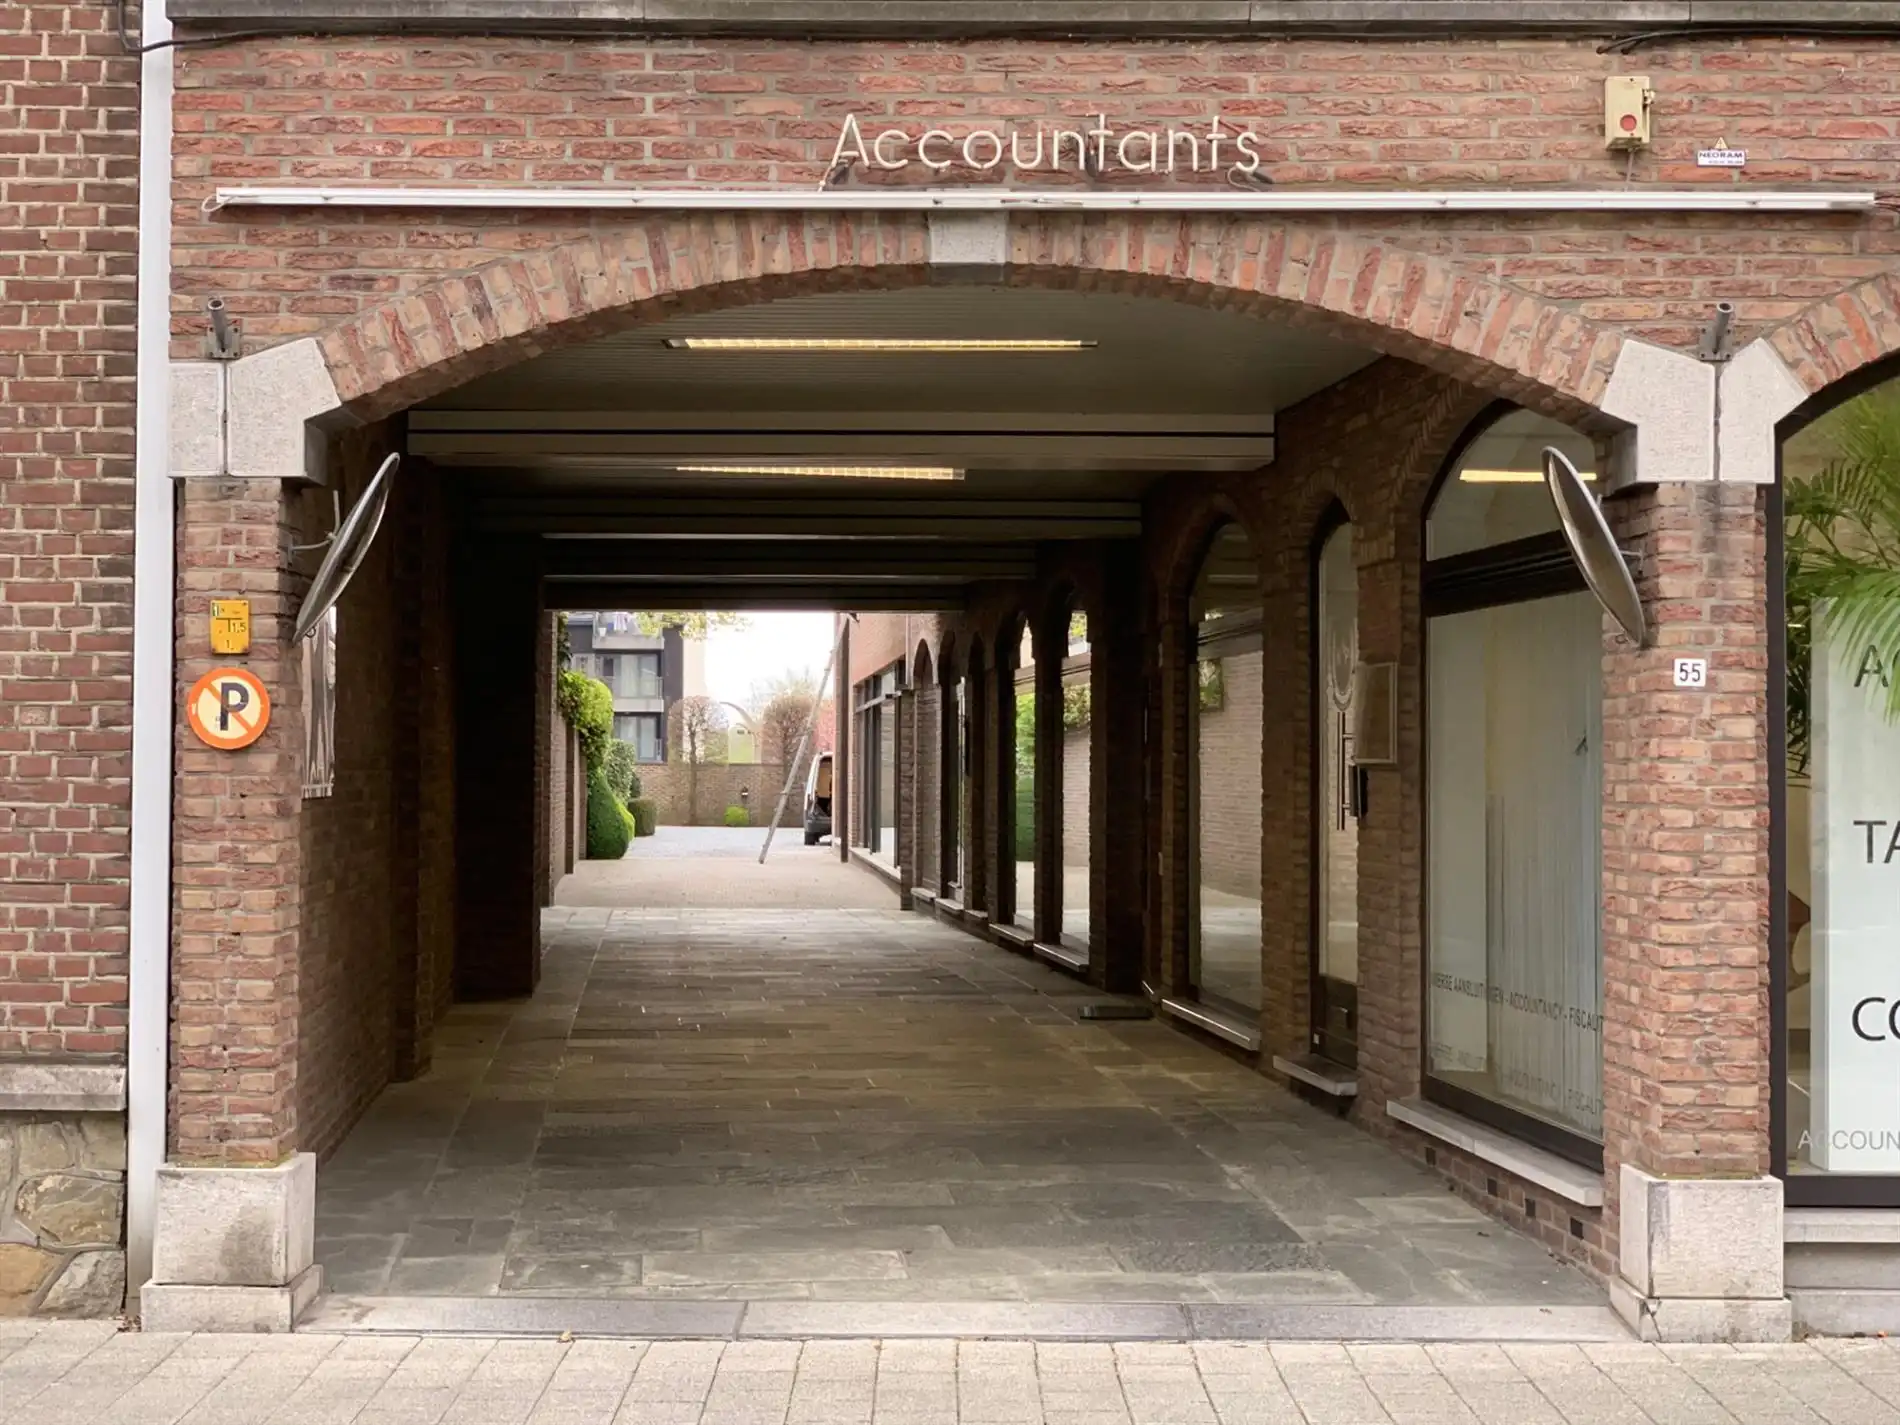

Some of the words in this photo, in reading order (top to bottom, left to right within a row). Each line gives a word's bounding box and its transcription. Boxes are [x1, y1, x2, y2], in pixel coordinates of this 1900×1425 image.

[831, 113, 1261, 173] Accountants
[1680, 662, 1701, 682] 55
[1854, 644, 1900, 688] A
[220, 682, 249, 731] P
[1852, 997, 1900, 1041] C
